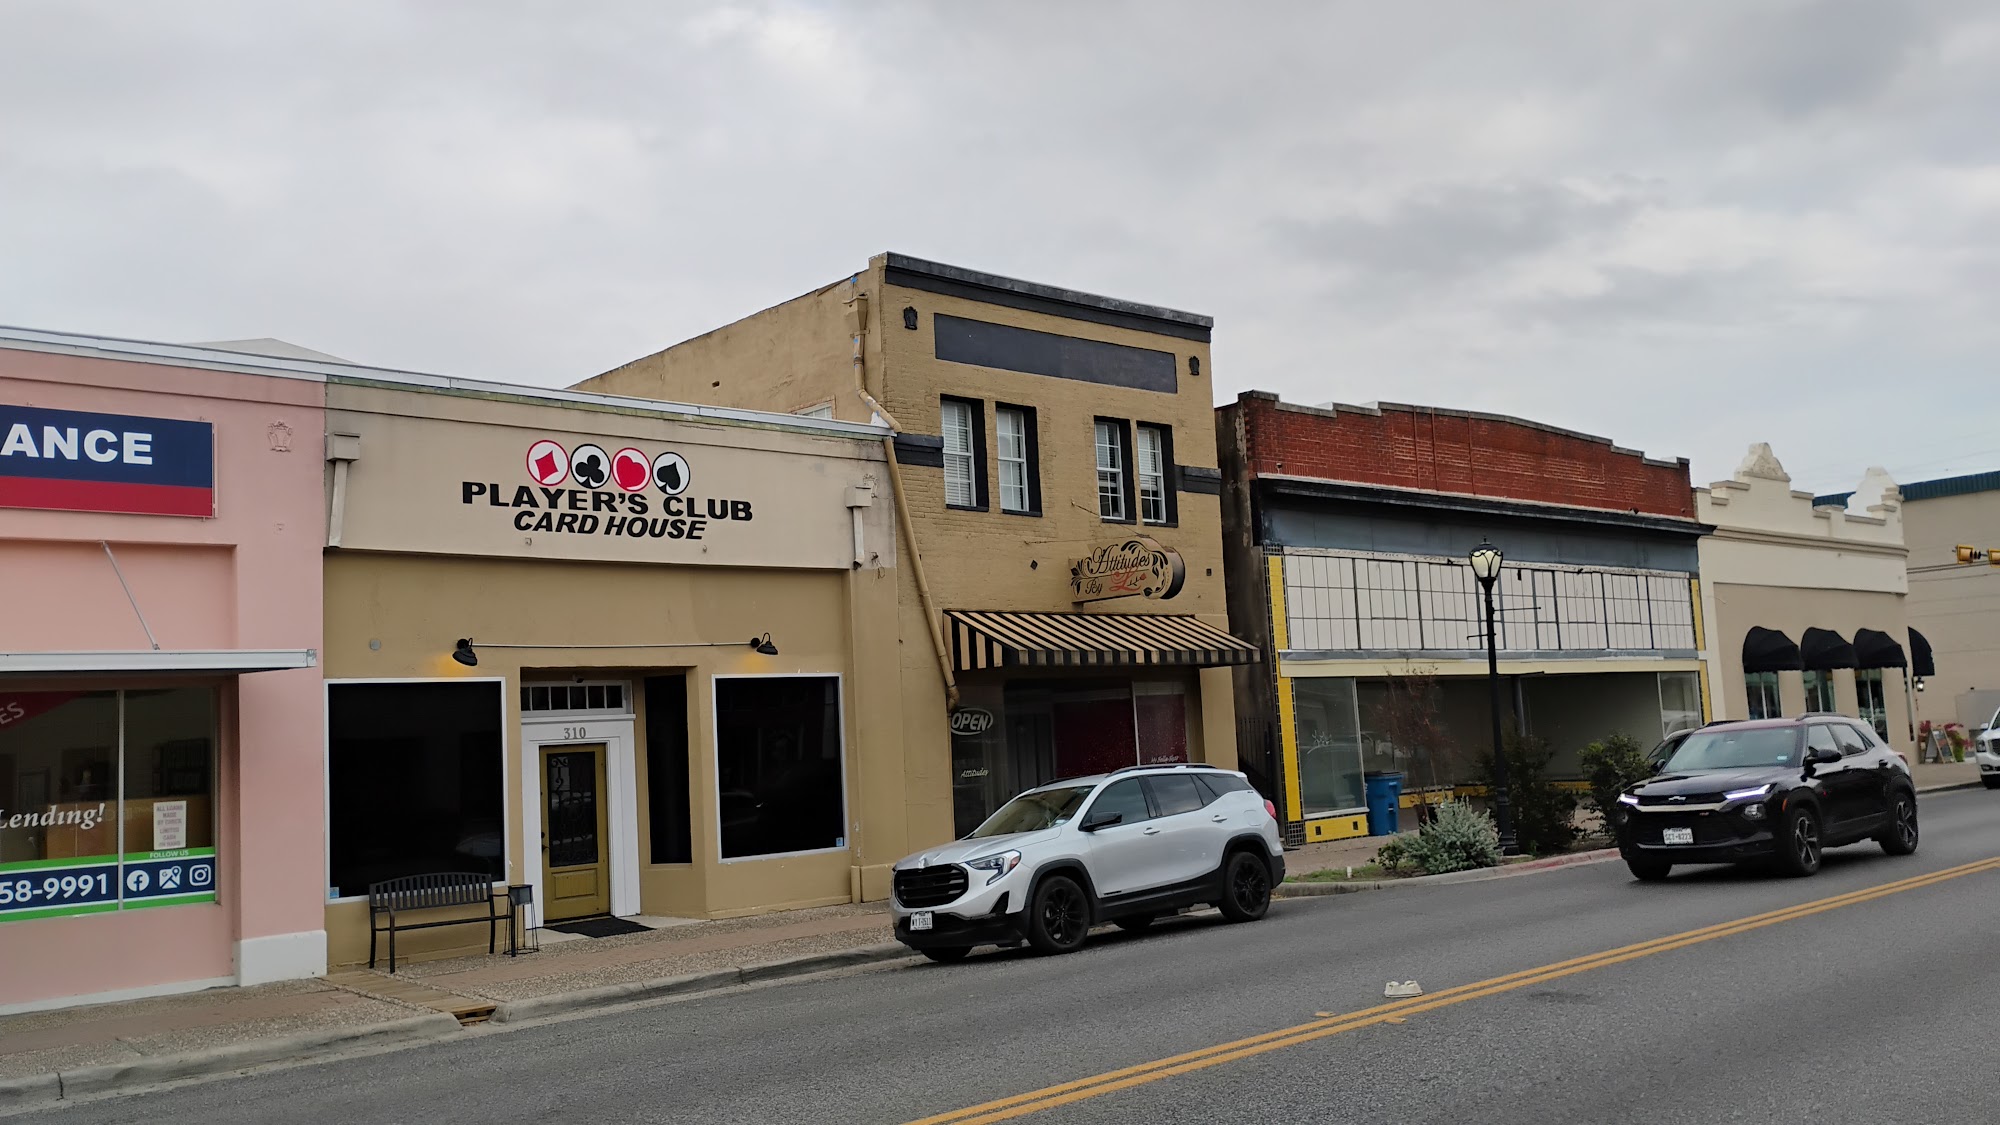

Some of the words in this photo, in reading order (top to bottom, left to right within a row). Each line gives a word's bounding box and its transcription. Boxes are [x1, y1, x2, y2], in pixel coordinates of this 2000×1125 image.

[0, 423, 153, 466] ANCE
[461, 481, 649, 515] PLAYER'S
[663, 496, 754, 522] CLUB
[513, 510, 600, 535] CARD
[603, 516, 708, 540] HOUSE
[1089, 543, 1151, 574] Attitudes
[563, 727, 587, 740] 310
[951, 712, 989, 731] OPEN
[150, 850, 179, 859] FOLLOW
[0, 873, 108, 904] 58-9991
